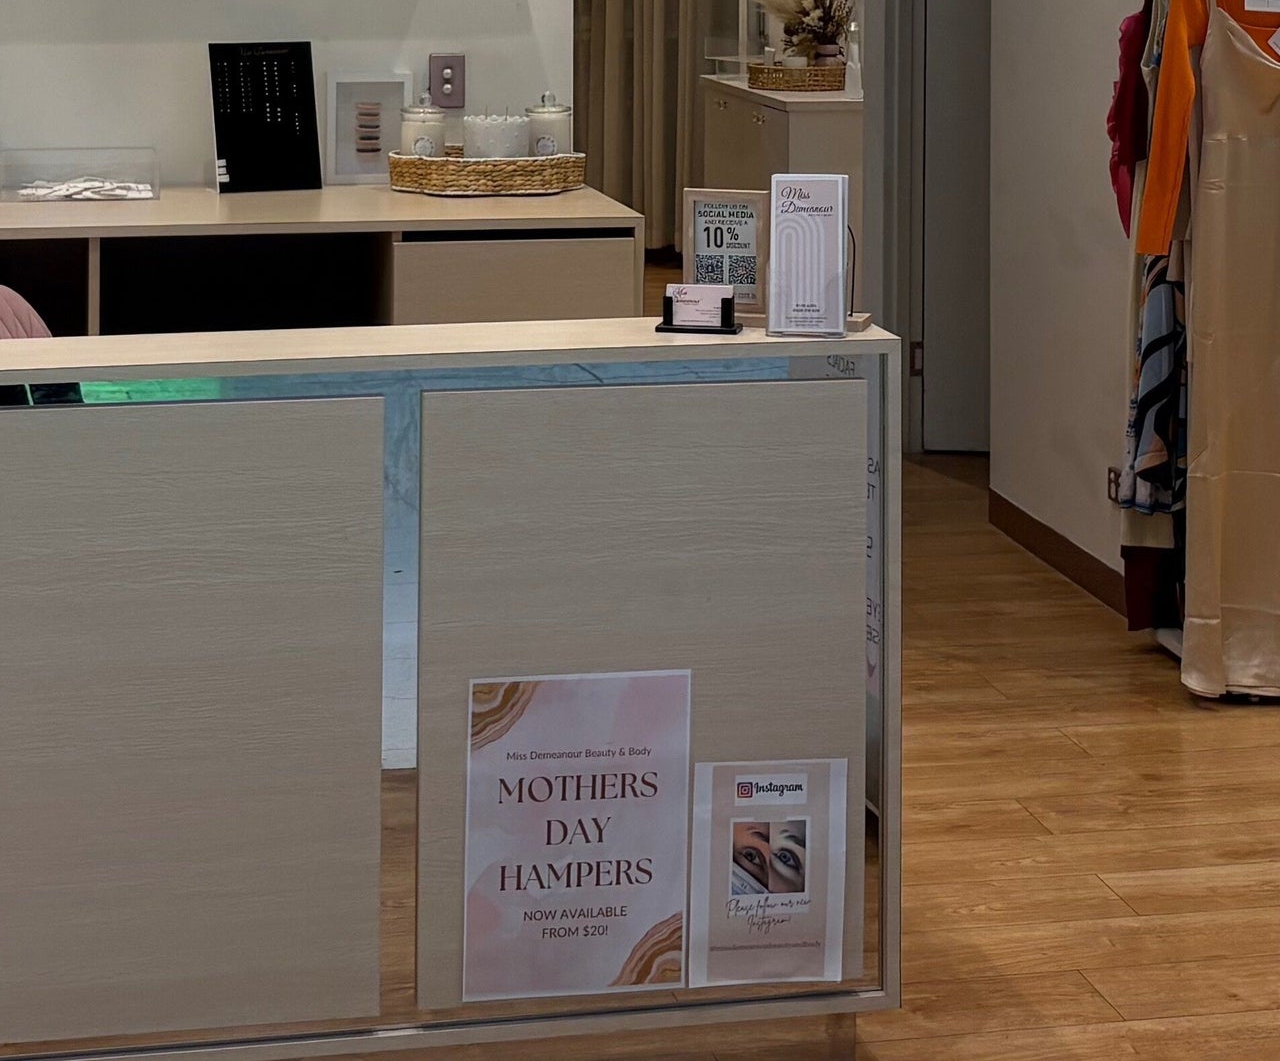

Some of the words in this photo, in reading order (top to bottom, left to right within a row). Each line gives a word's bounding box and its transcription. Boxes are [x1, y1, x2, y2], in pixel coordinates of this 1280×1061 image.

[780, 186, 811, 201] Miss
[698, 210, 727, 218] SOCIAL
[728, 211, 754, 219] MEDIA
[506, 750, 527, 761] Miss
[529, 749, 583, 761] Demeanour
[585, 748, 617, 760] Beauty
[619, 747, 627, 757] &
[628, 745, 652, 758] Body
[498, 771, 659, 805] MOTHERS
[754, 780, 803, 795] Instagram
[545, 816, 612, 846] DAY
[499, 858, 654, 892] HAMPERS
[523, 907, 557, 923] NOW
[559, 905, 628, 922] AVAILABLE
[542, 925, 579, 938] FROM
[582, 924, 609, 938] $20!
